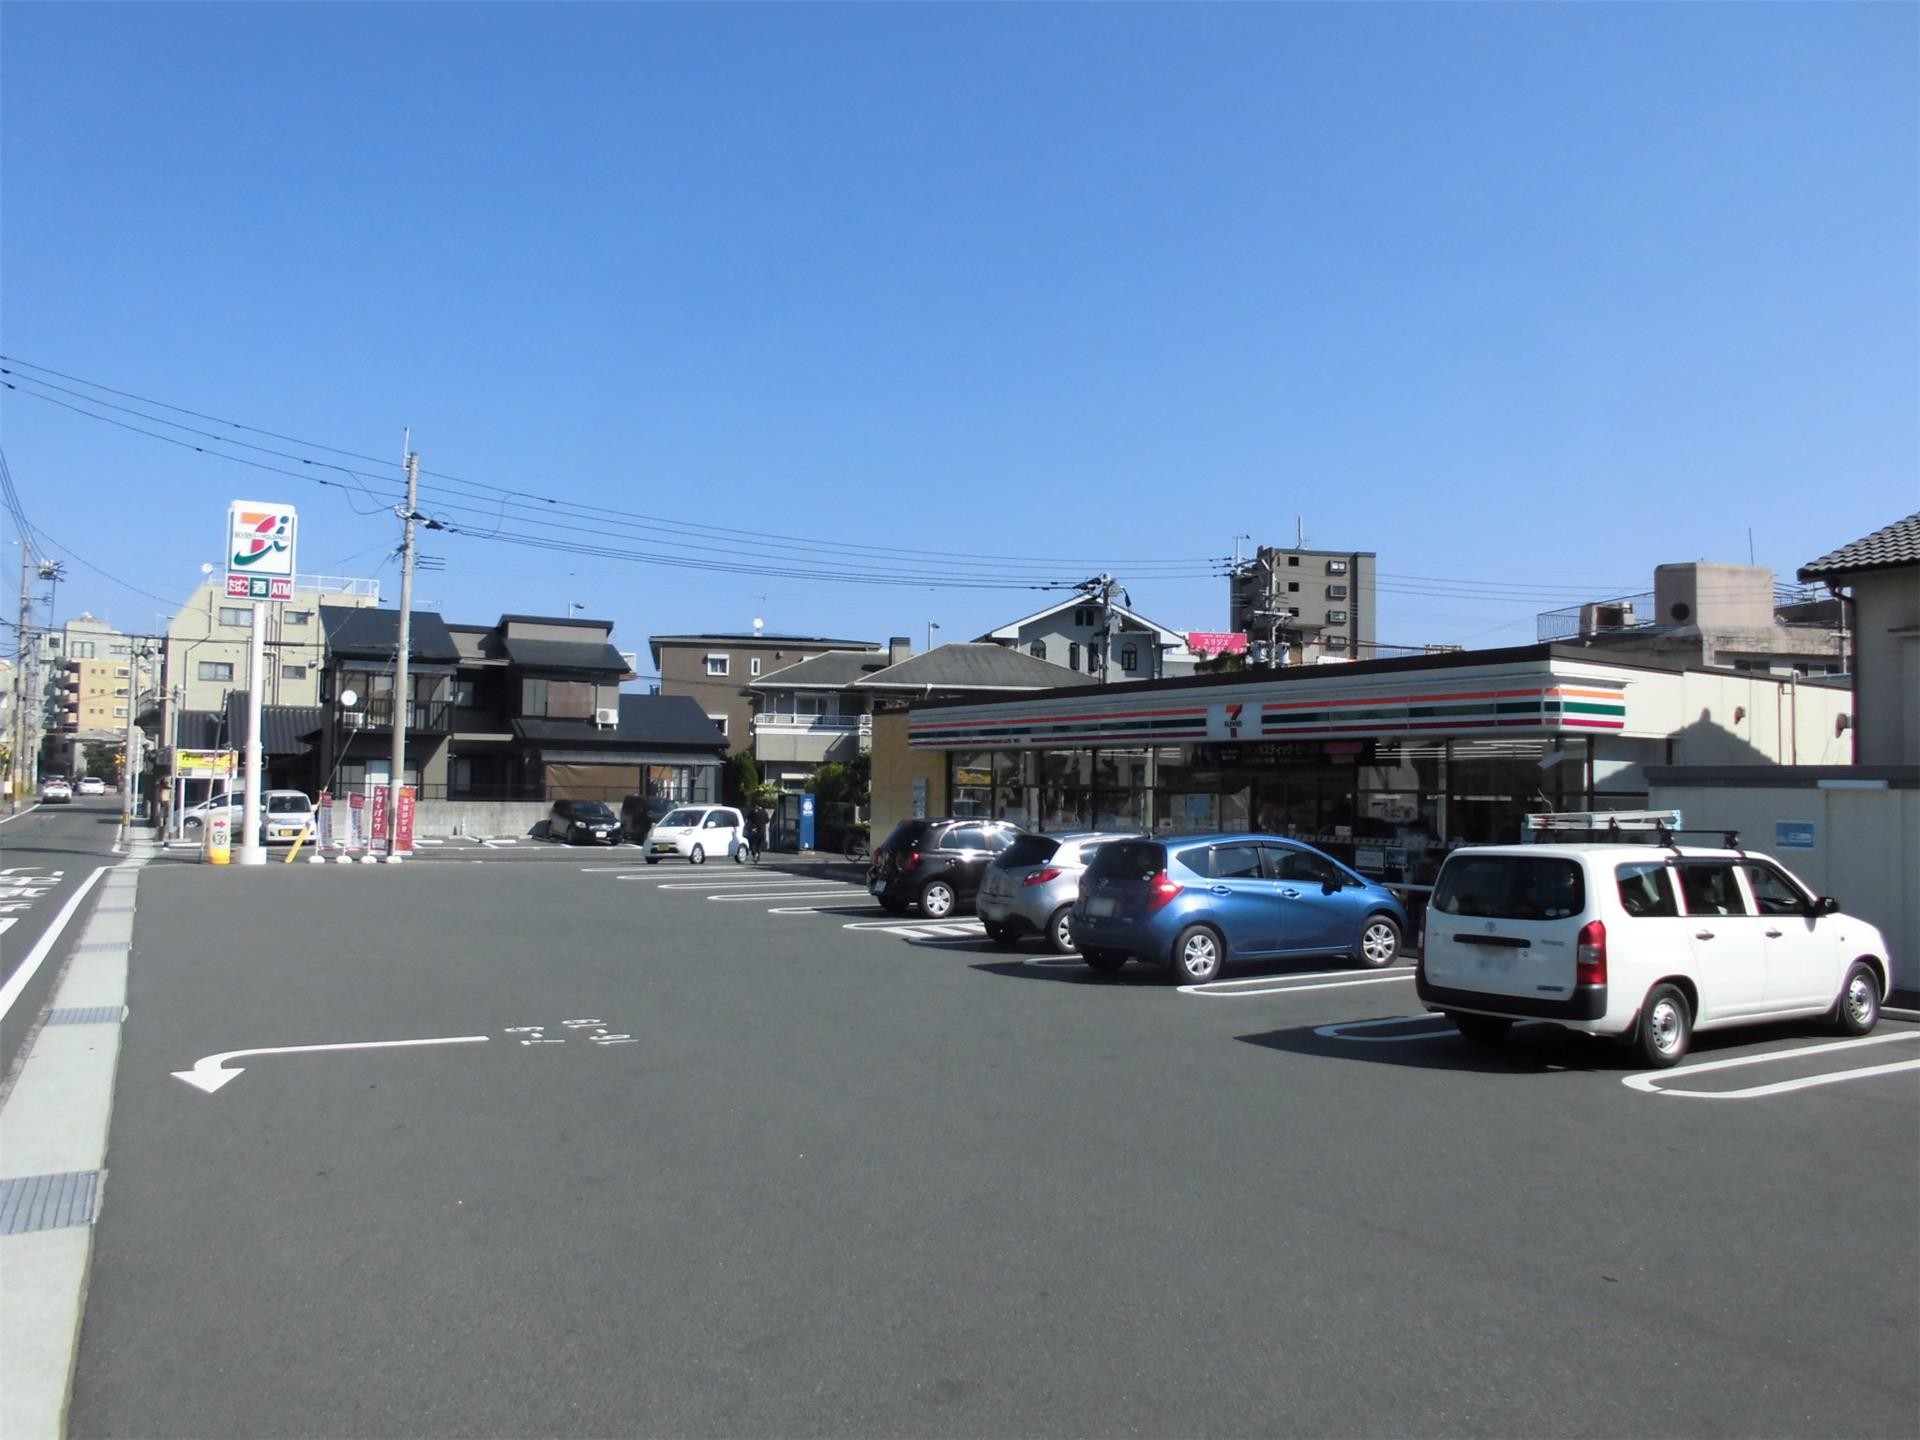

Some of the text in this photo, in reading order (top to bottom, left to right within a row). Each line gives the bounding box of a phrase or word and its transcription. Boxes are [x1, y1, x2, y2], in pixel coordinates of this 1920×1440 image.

[272, 582, 291, 595] ATM
[373, 788, 384, 831] レターパック
